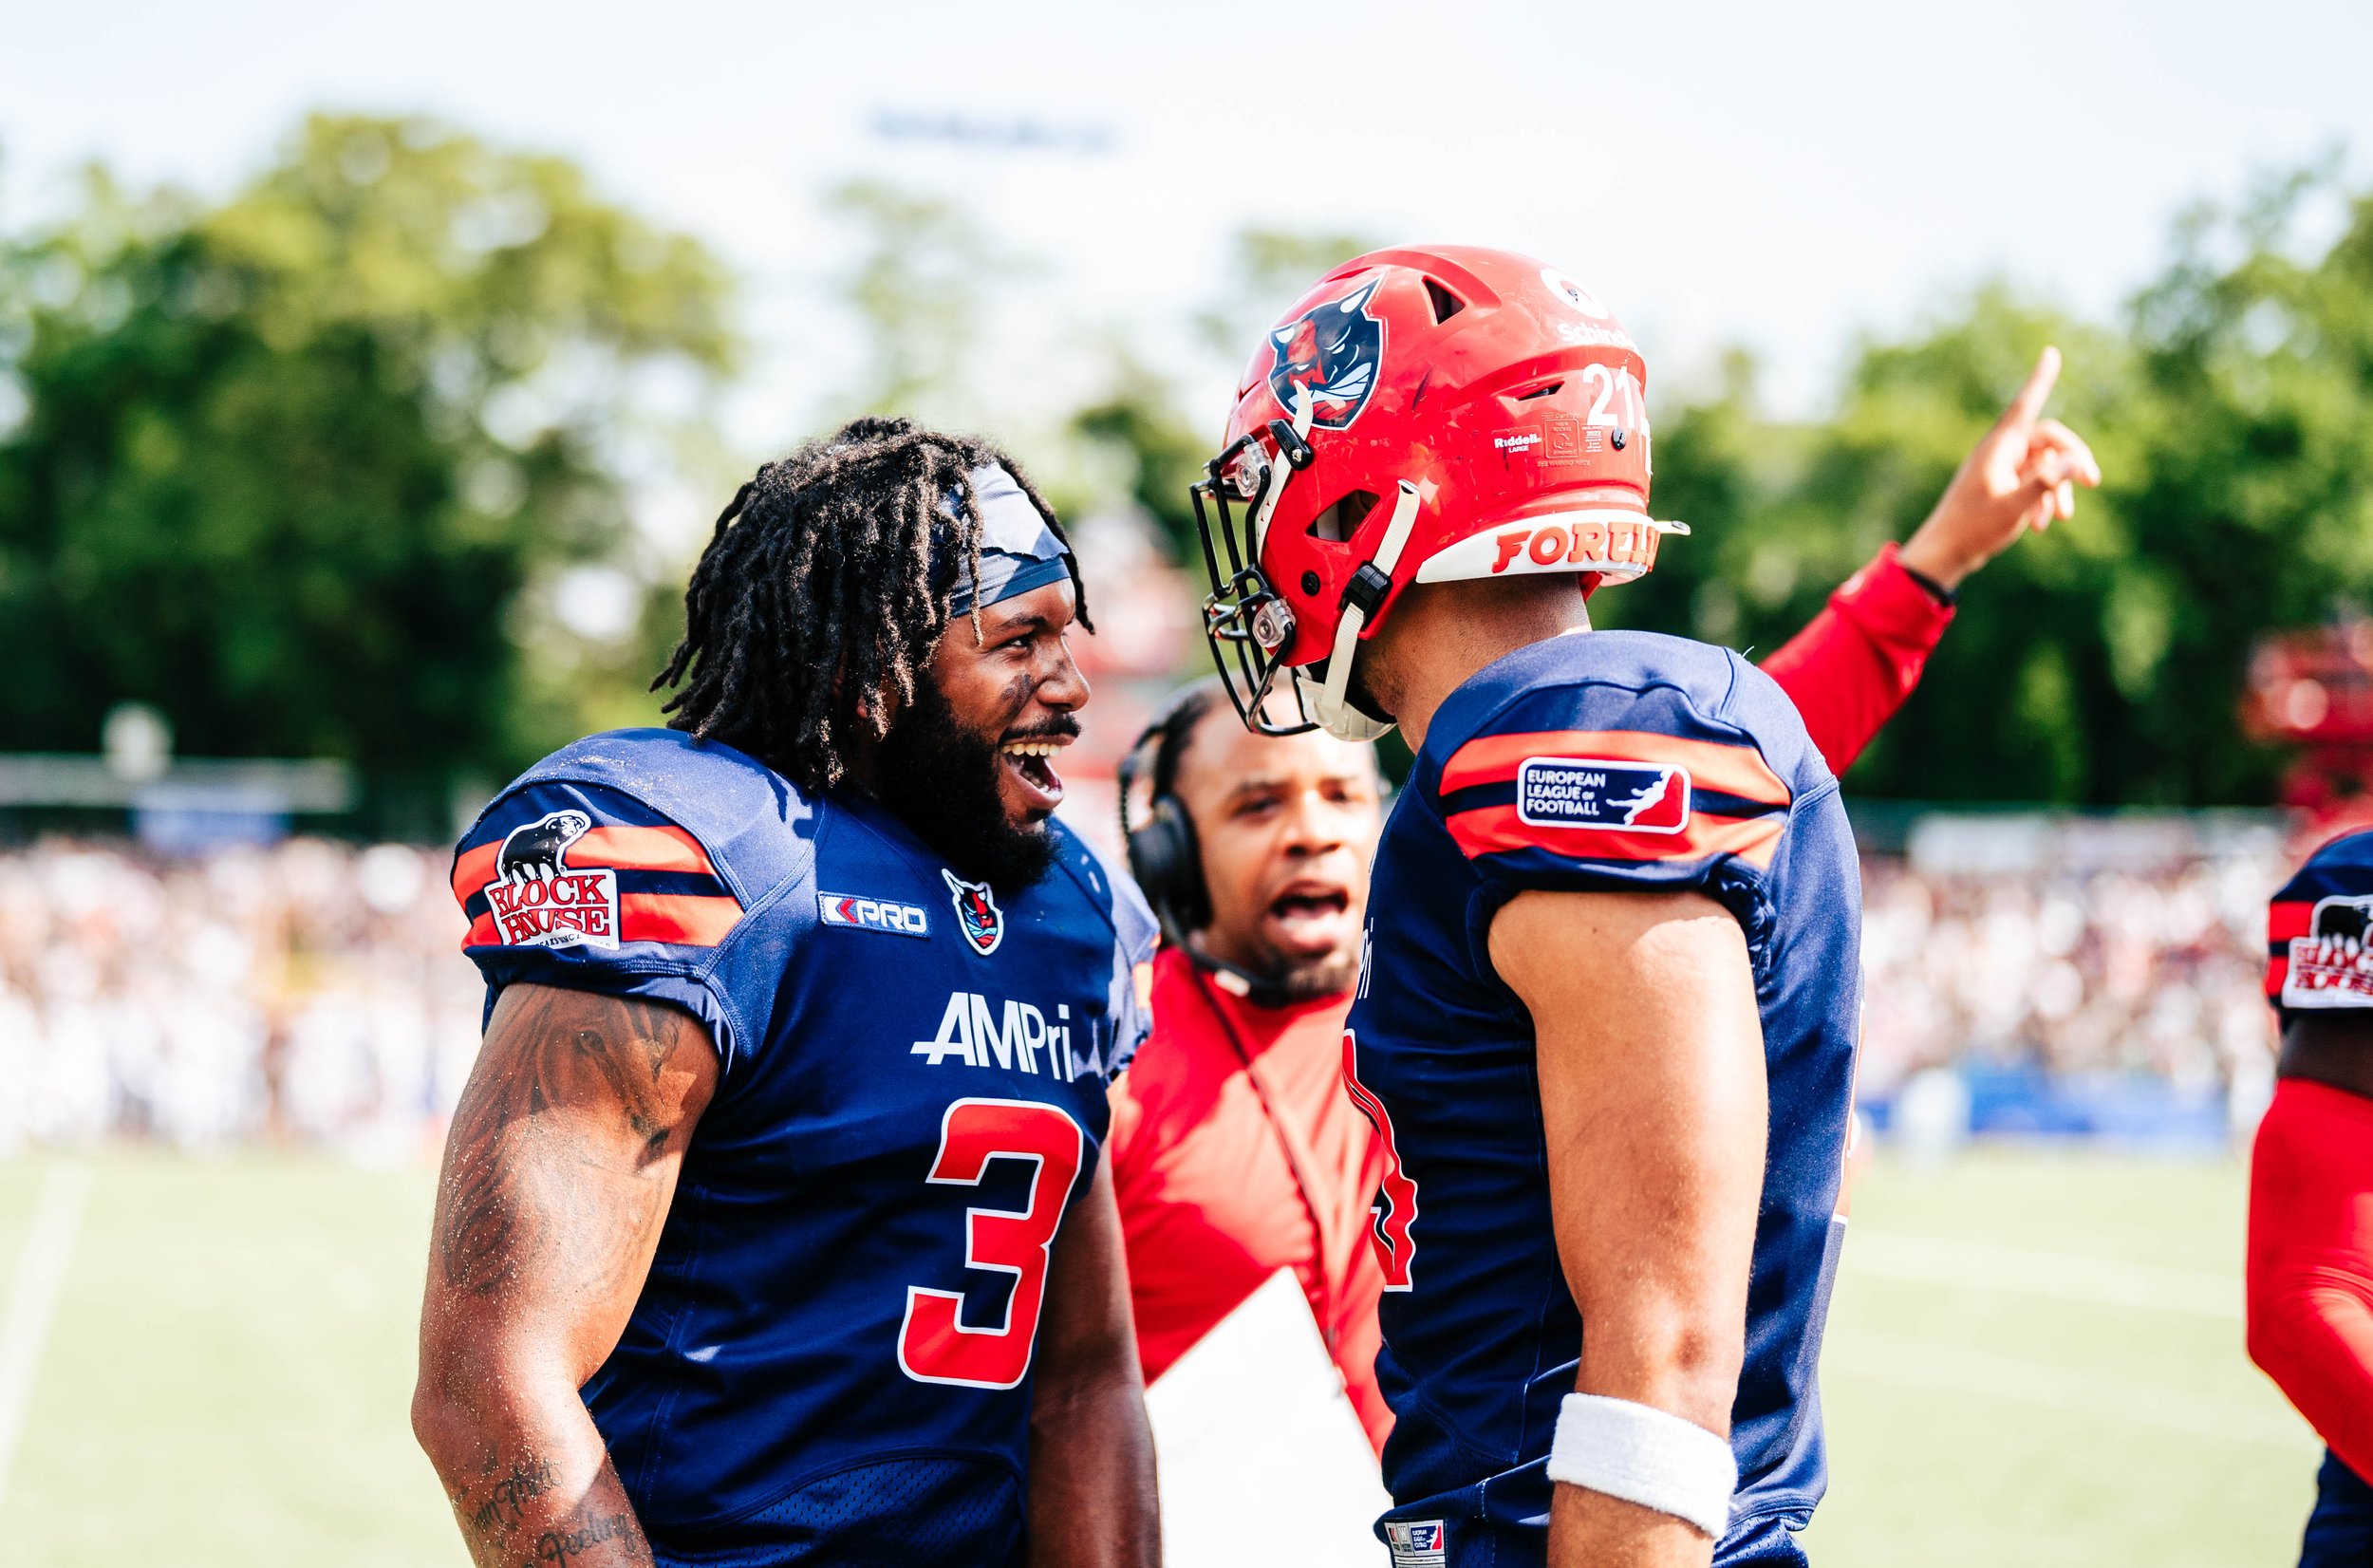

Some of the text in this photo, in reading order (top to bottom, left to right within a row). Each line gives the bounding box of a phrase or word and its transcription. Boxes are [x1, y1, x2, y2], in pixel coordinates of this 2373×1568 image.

[1582, 363, 1635, 430] 21
[1494, 433, 1538, 448] Riddell
[1526, 784, 1581, 800] LEAGUE
[1527, 770, 1606, 788] EUROPEAN
[1526, 798, 1599, 815] FOOTBALL
[489, 875, 608, 917] BLOCK
[501, 906, 609, 944] HOUSE
[909, 991, 1074, 1083] AMPri
[897, 1097, 1084, 1391] 3
